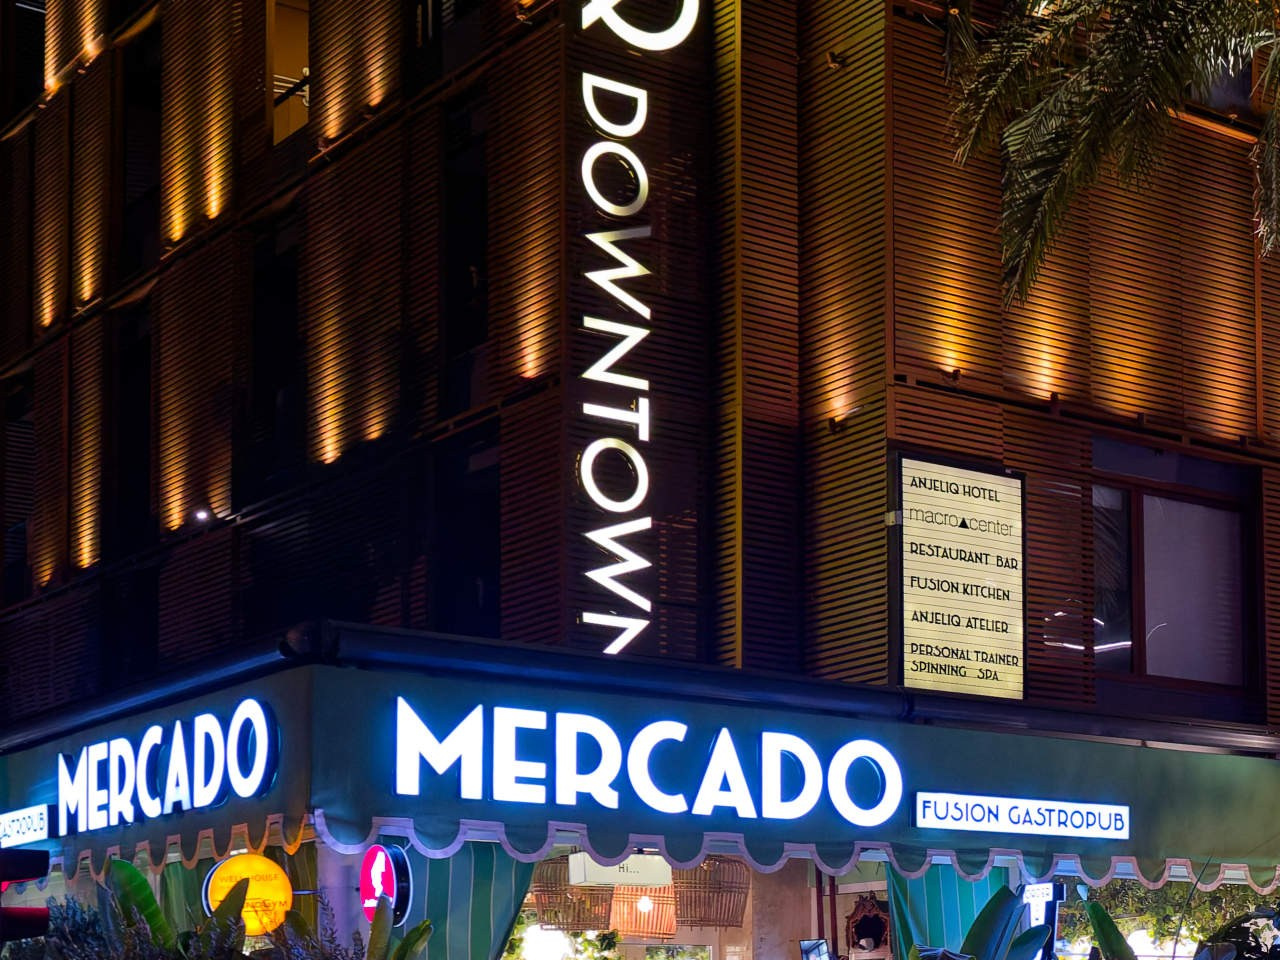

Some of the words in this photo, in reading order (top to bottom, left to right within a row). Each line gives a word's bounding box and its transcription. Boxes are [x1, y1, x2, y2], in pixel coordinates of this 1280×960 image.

[581, 72, 652, 655] DOWNTOWN
[910, 476, 960, 495] ANJELIQ
[962, 484, 1001, 503] HOTEL
[910, 541, 991, 566] RESTAURANT
[996, 555, 1018, 570] BAR
[910, 575, 960, 594] FUSION
[962, 582, 1010, 601] KITCHEN
[911, 609, 961, 627] ANJELIQ
[965, 616, 1009, 634] ATELIER
[910, 642, 972, 661] PERSONAL
[974, 650, 1019, 667] TRAINER
[910, 660, 967, 678] SPINNING
[977, 667, 999, 682] SPA
[57, 697, 270, 837] MERCADO
[395, 695, 904, 827] MERCADO
[922, 800, 999, 823] FUSION
[1008, 805, 1125, 832] GASTROPUB
